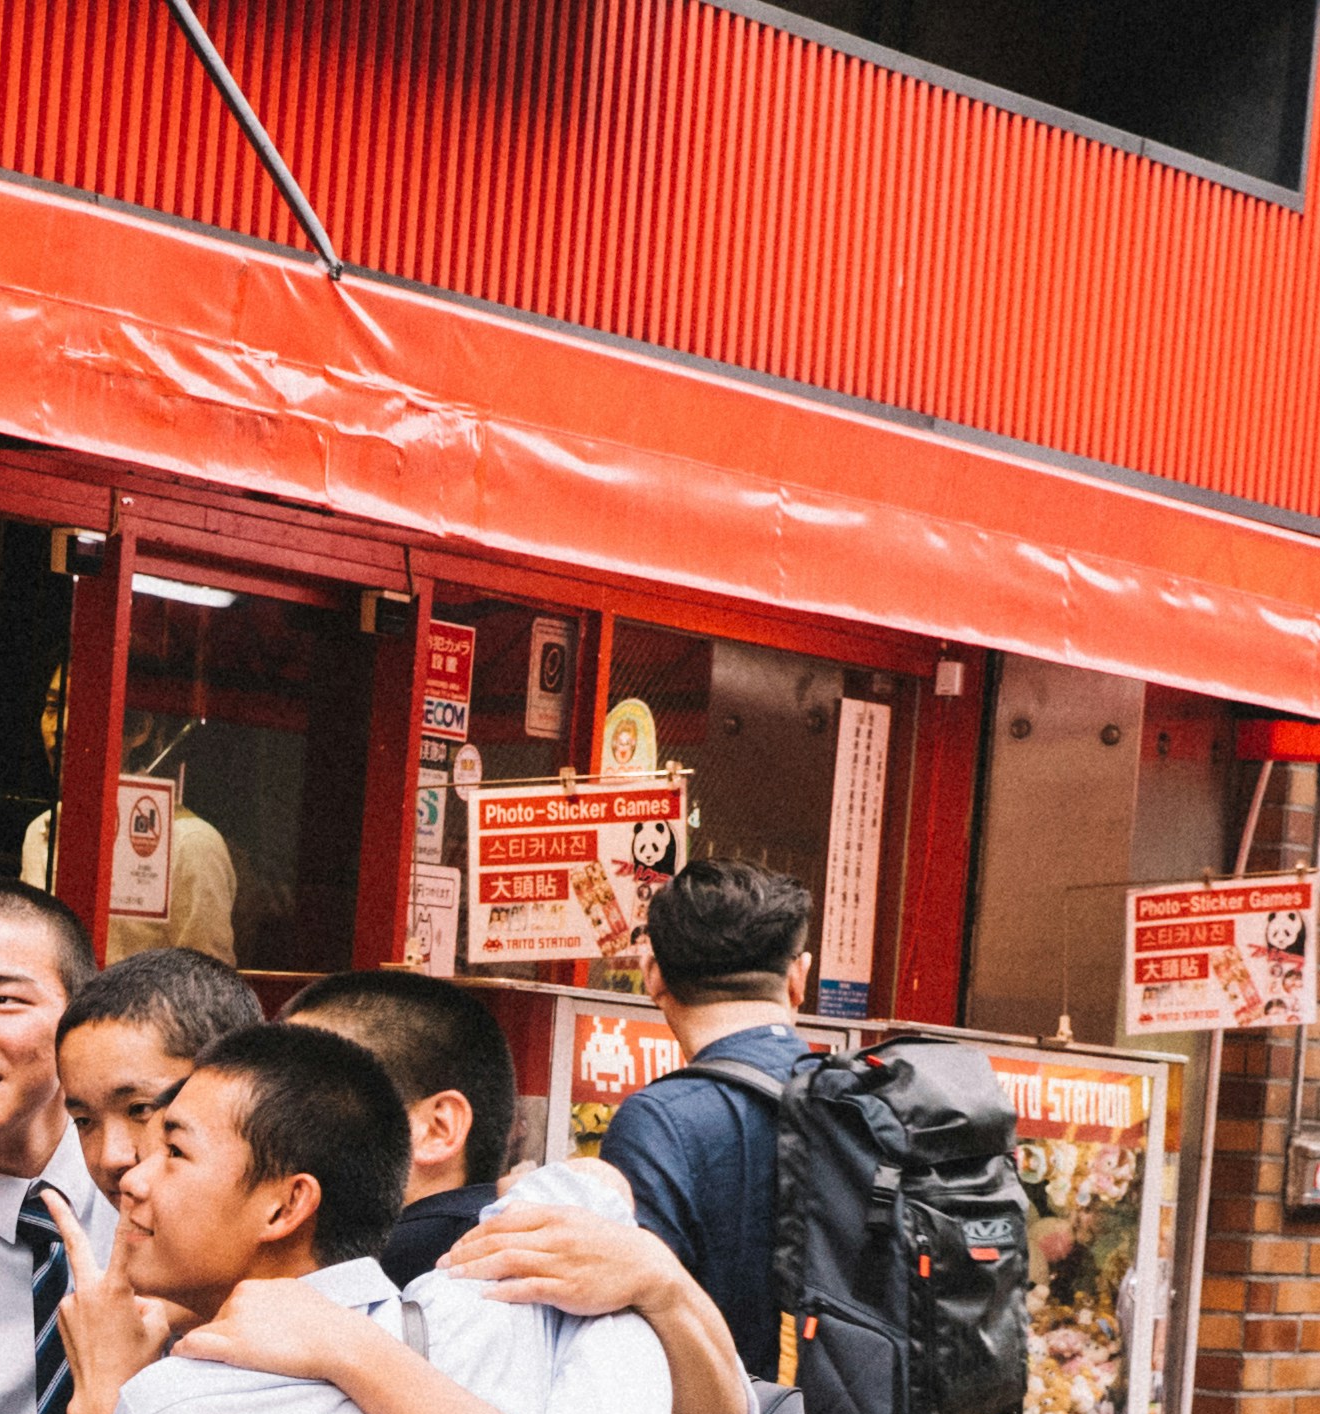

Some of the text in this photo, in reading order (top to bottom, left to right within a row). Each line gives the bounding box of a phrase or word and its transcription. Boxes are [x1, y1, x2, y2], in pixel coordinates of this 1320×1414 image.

[424, 700, 465, 730] ECOM
[485, 797, 670, 824] Photo-Sticker Games
[488, 834, 586, 859] 스티커사진
[490, 873, 557, 900] 大頭貼
[1139, 890, 1302, 918] Photo-Sticker Games
[506, 936, 581, 950] TAITO STATION
[1143, 957, 1199, 982] 大頭貼
[1047, 1076, 1132, 1129] STATION
